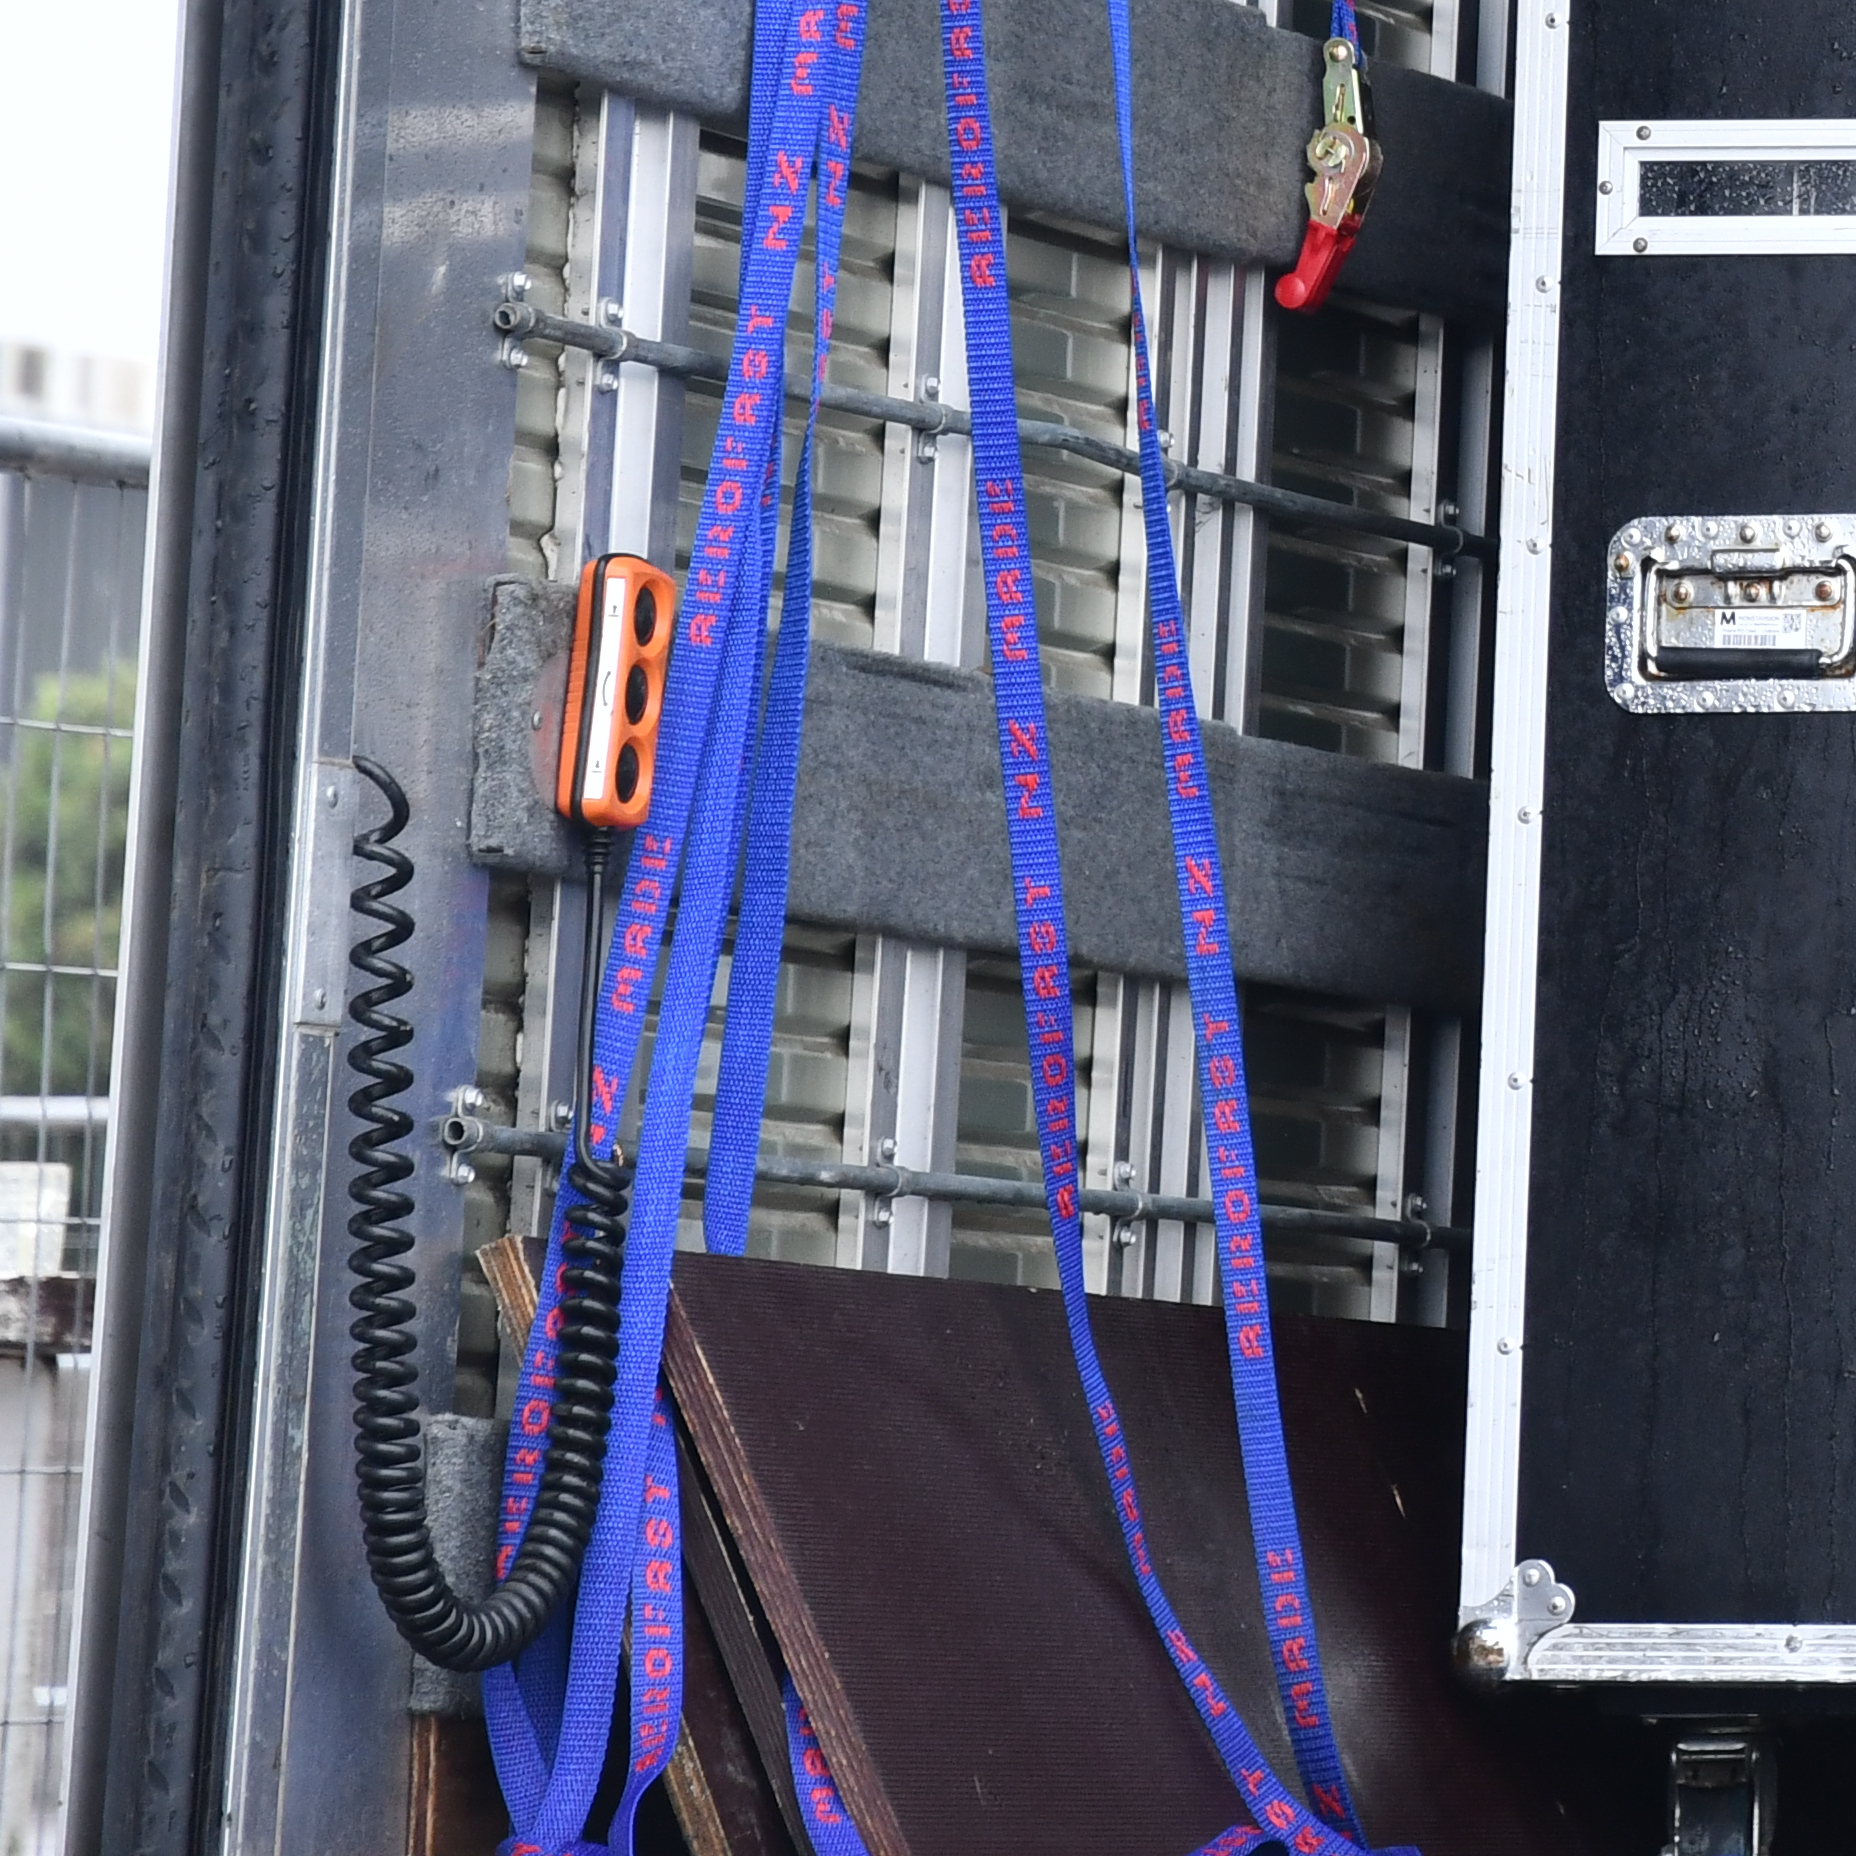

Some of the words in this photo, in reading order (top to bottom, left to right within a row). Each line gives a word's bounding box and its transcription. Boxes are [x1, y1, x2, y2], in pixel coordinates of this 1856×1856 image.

[688, 304, 775, 647] AEROFAST
[985, 478, 1028, 661] MADE
[1720, 611, 1737, 626] M
[1158, 619, 1199, 798] MADE
[611, 834, 673, 1013] MADE
[1023, 876, 1076, 1220] AEROFAST
[1202, 1011, 1263, 1360] AEROFAST
[1266, 1547, 1319, 1728] MADE
